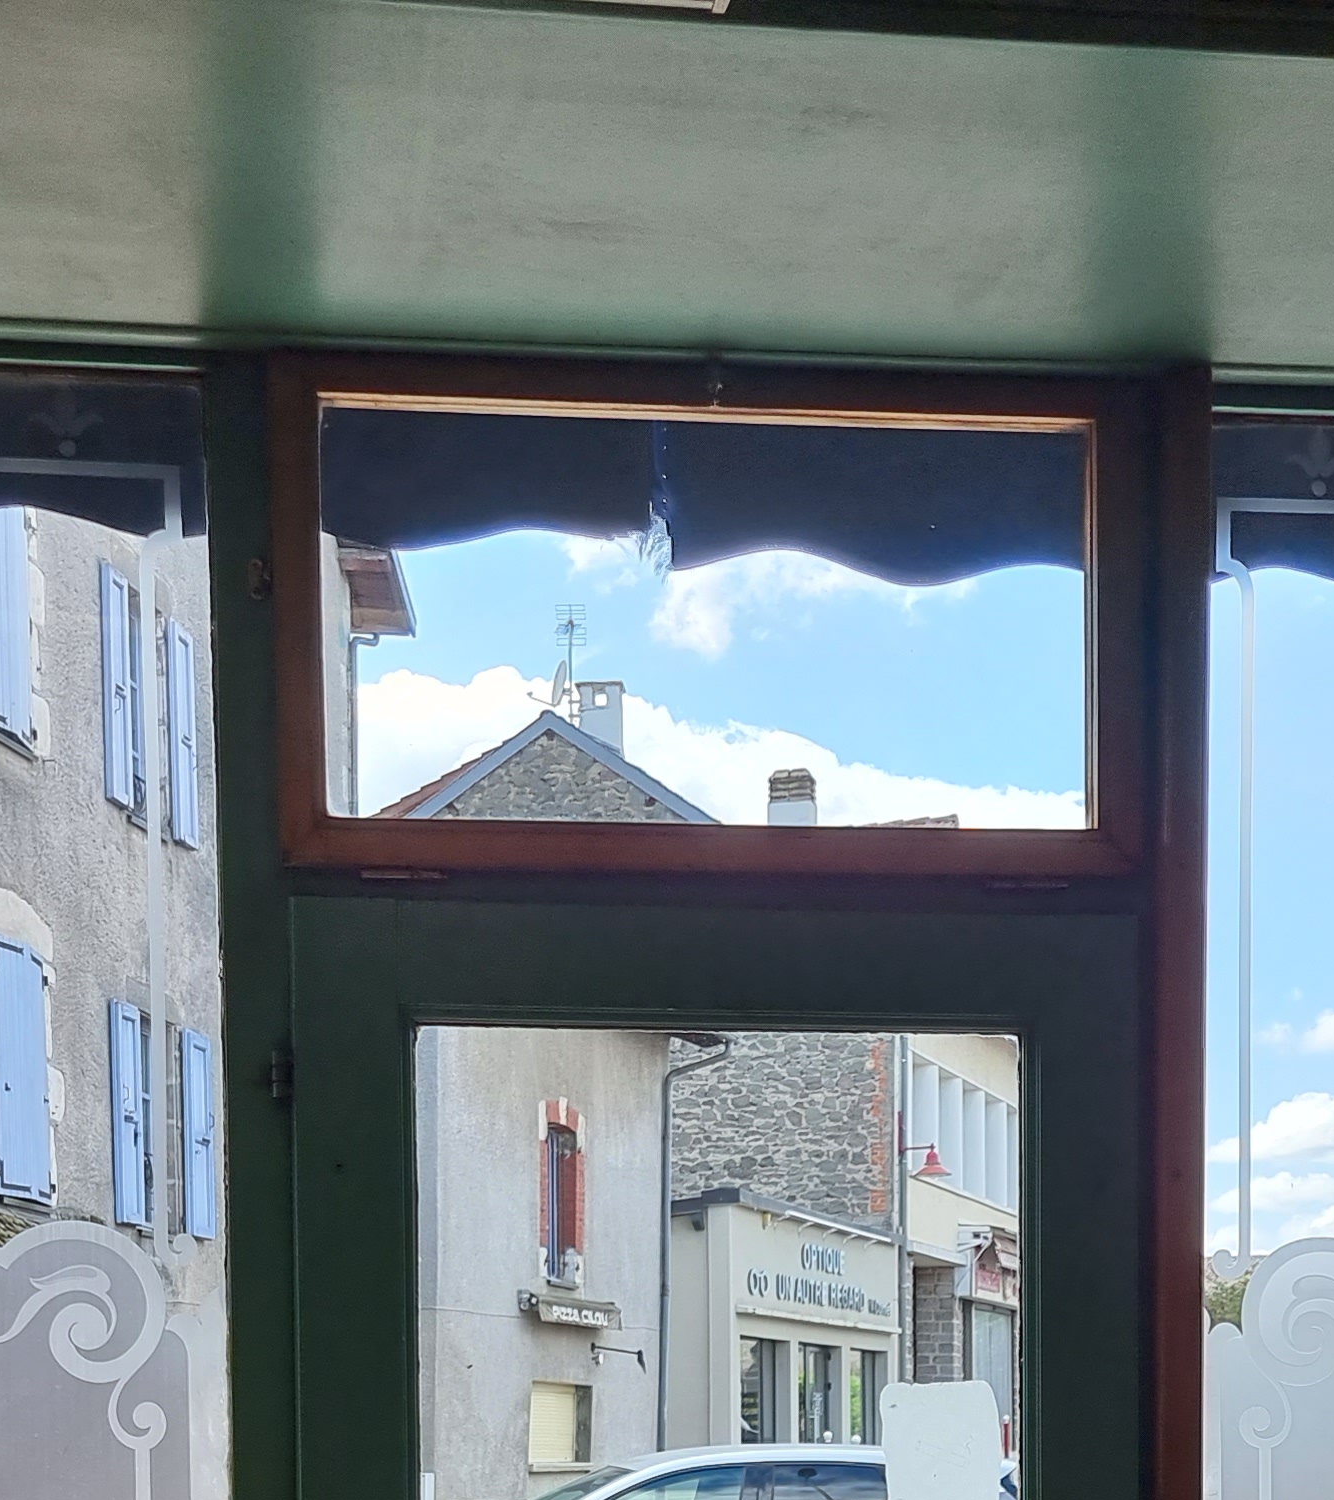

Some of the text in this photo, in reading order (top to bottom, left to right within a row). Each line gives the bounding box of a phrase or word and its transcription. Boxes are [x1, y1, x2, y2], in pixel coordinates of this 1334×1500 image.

[801, 1243, 846, 1276] OPTIQUE
[776, 1273, 791, 1301] UN
[794, 1277, 828, 1307] AUTRE
[828, 1282, 865, 1312] REGARD
